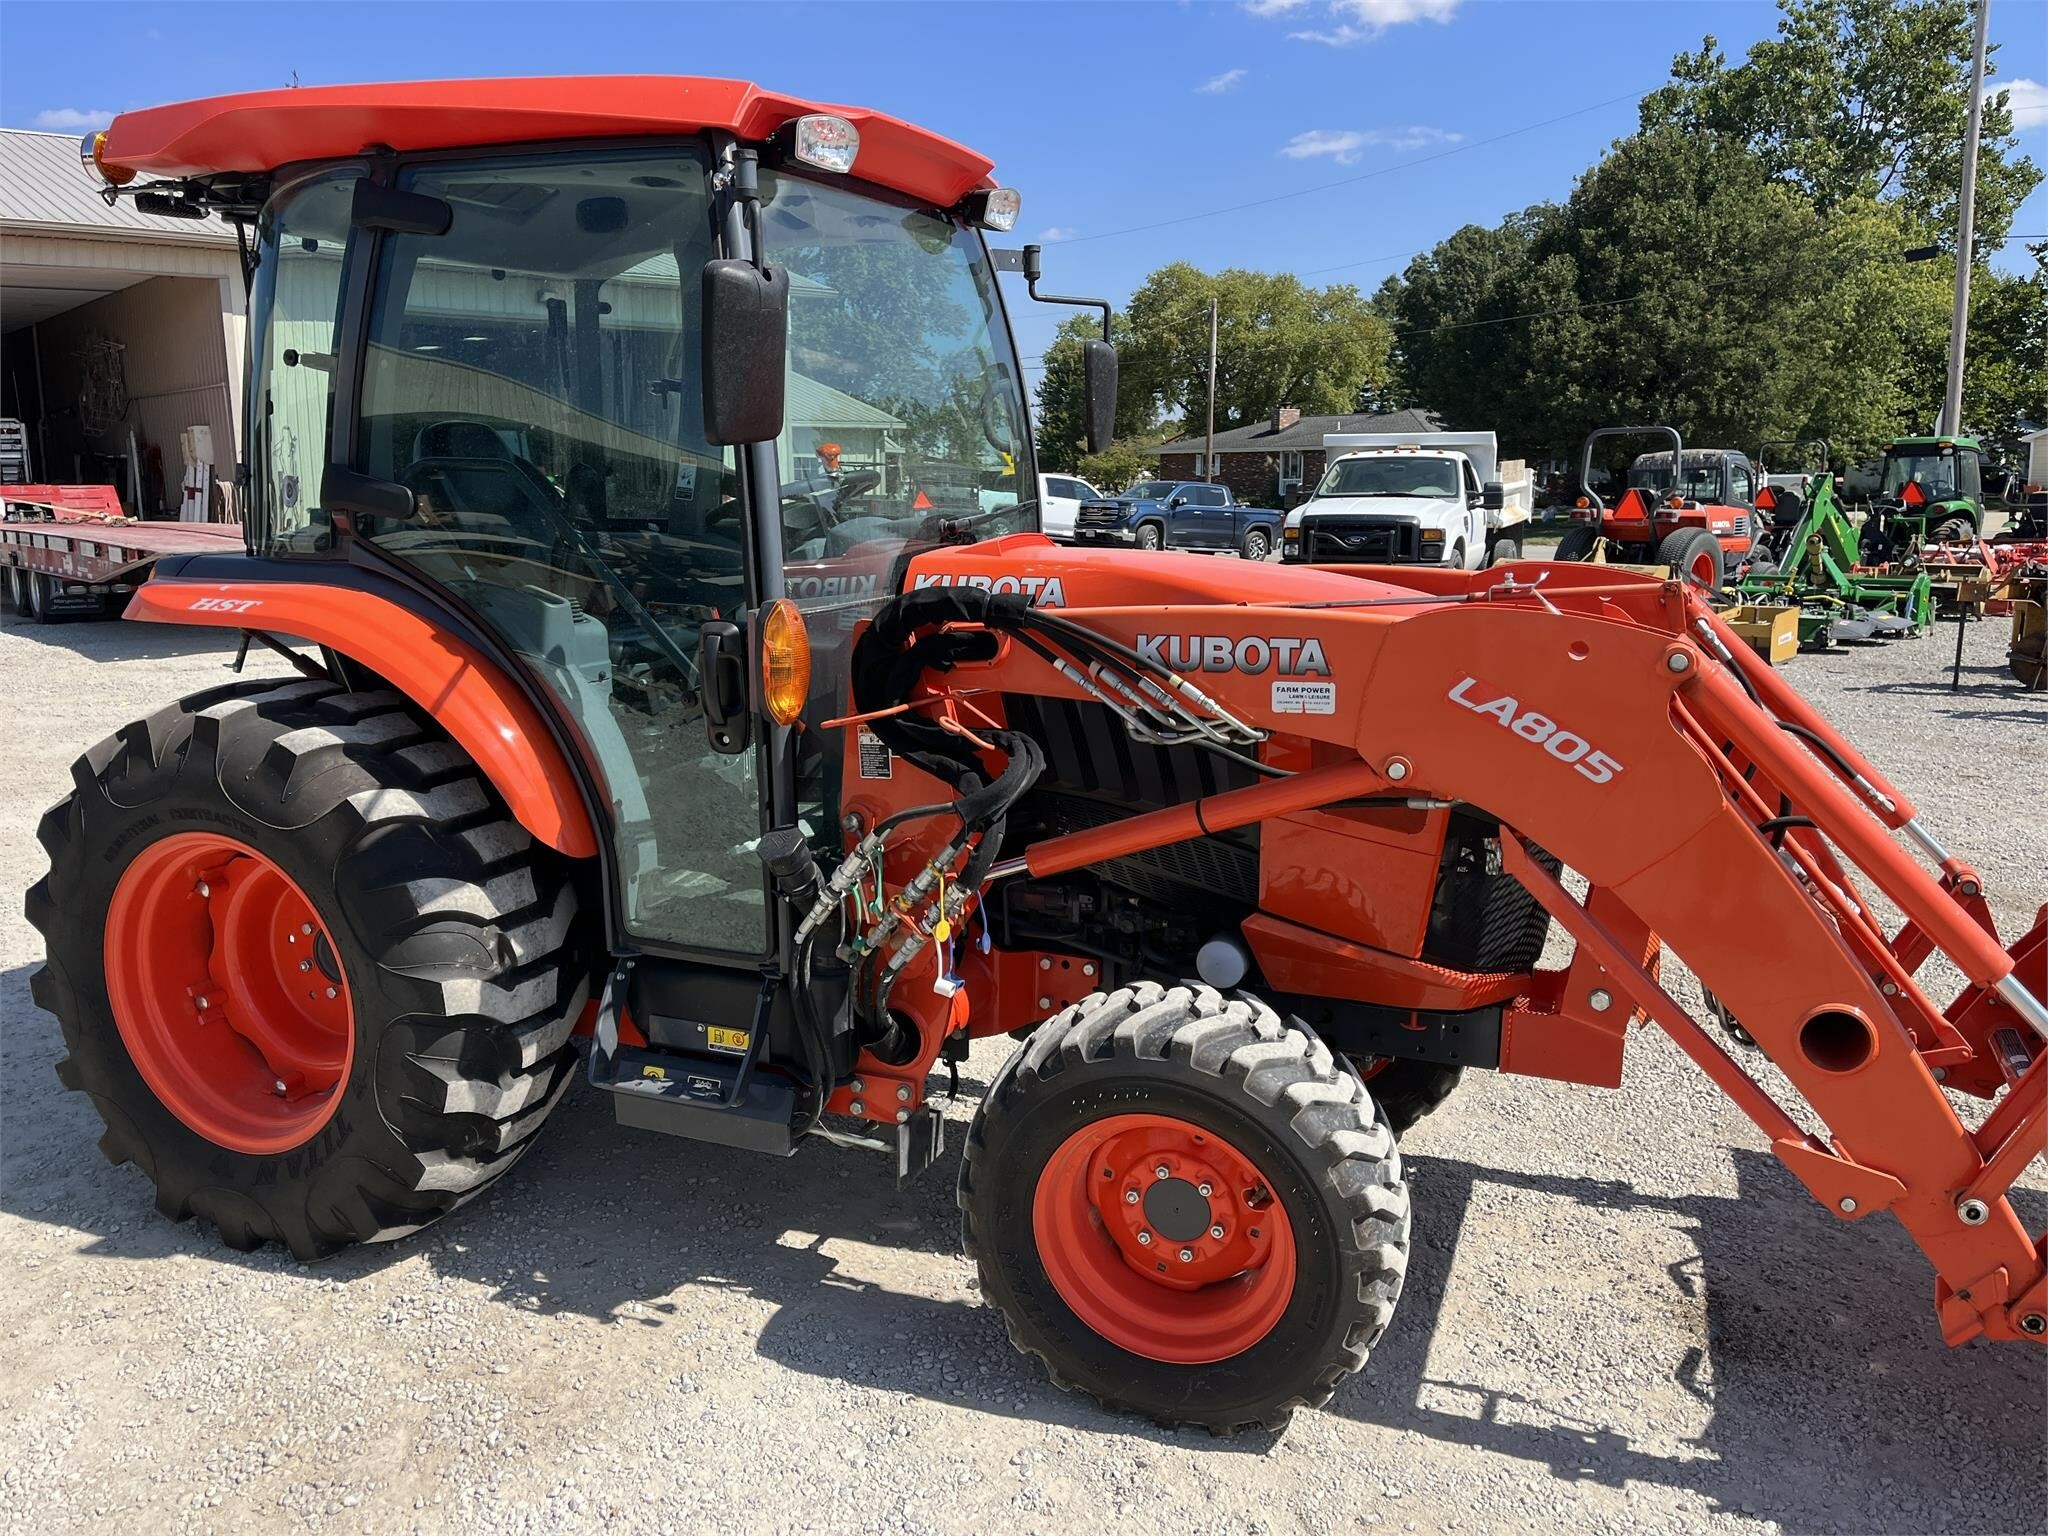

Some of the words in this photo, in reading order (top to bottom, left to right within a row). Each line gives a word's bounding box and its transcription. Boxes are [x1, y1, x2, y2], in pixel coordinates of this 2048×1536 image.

[187, 597, 263, 613] HST
[1135, 634, 1333, 677] KUBOTA
[1447, 676, 1624, 785] LA805
